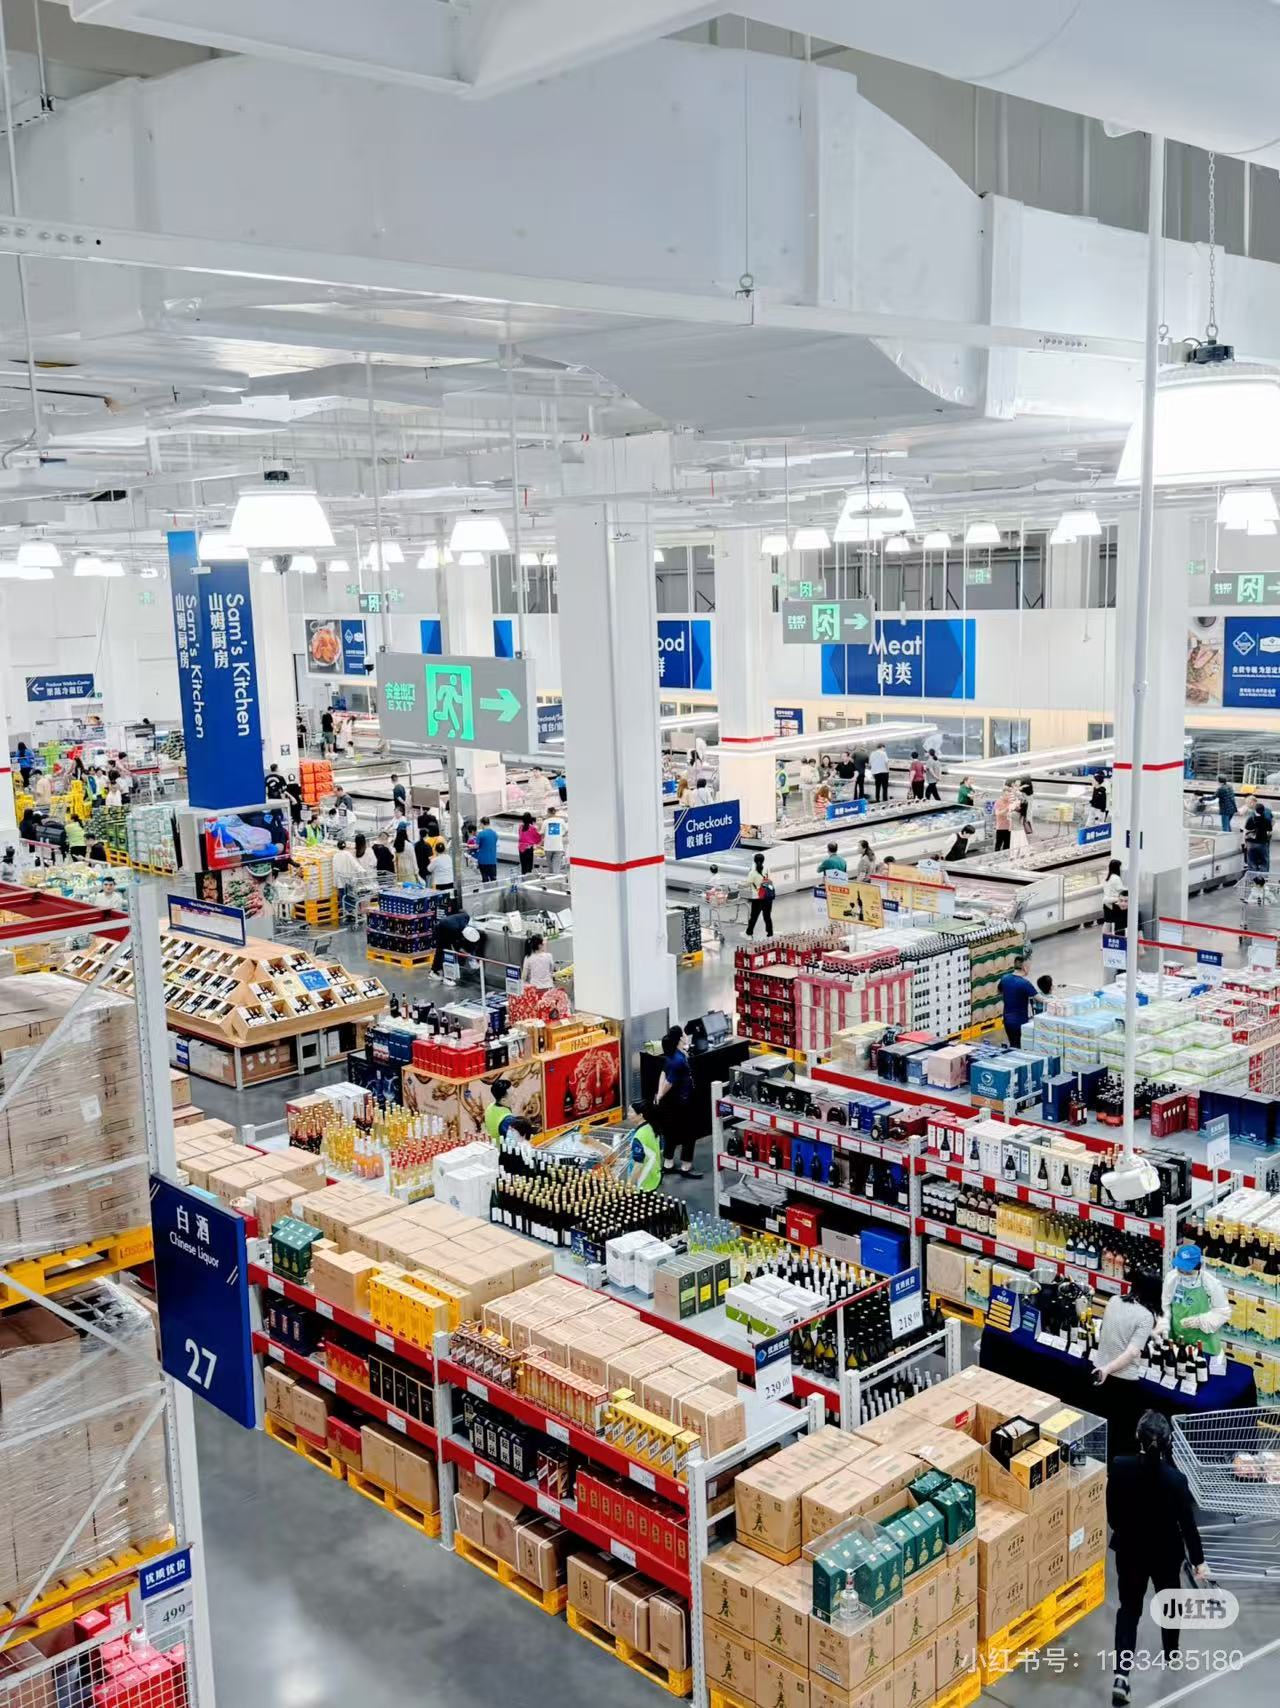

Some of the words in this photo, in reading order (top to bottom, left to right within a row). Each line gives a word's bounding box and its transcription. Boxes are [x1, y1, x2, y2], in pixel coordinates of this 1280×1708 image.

[175, 592, 189, 669] 山姆厨房
[185, 594, 201, 657] Sam's
[208, 592, 229, 669] 山姆厨房
[226, 593, 248, 656] Sam's
[868, 634, 922, 656] Meat
[384, 681, 416, 702] 安全出口
[877, 661, 912, 686] 肉类
[190, 664, 205, 738] Kitchen
[232, 662, 253, 737] Kitchen
[387, 701, 414, 712] EXIT
[685, 813, 733, 833] Checkouts
[686, 831, 712, 849] 收银台
[176, 1204, 209, 1245] 白酒
[169, 1231, 197, 1256] Chinese
[197, 1245, 219, 1268] Liquor
[184, 1338, 217, 1390] 27
[145, 1558, 186, 1586] 优质优价
[162, 1604, 186, 1623] 499
